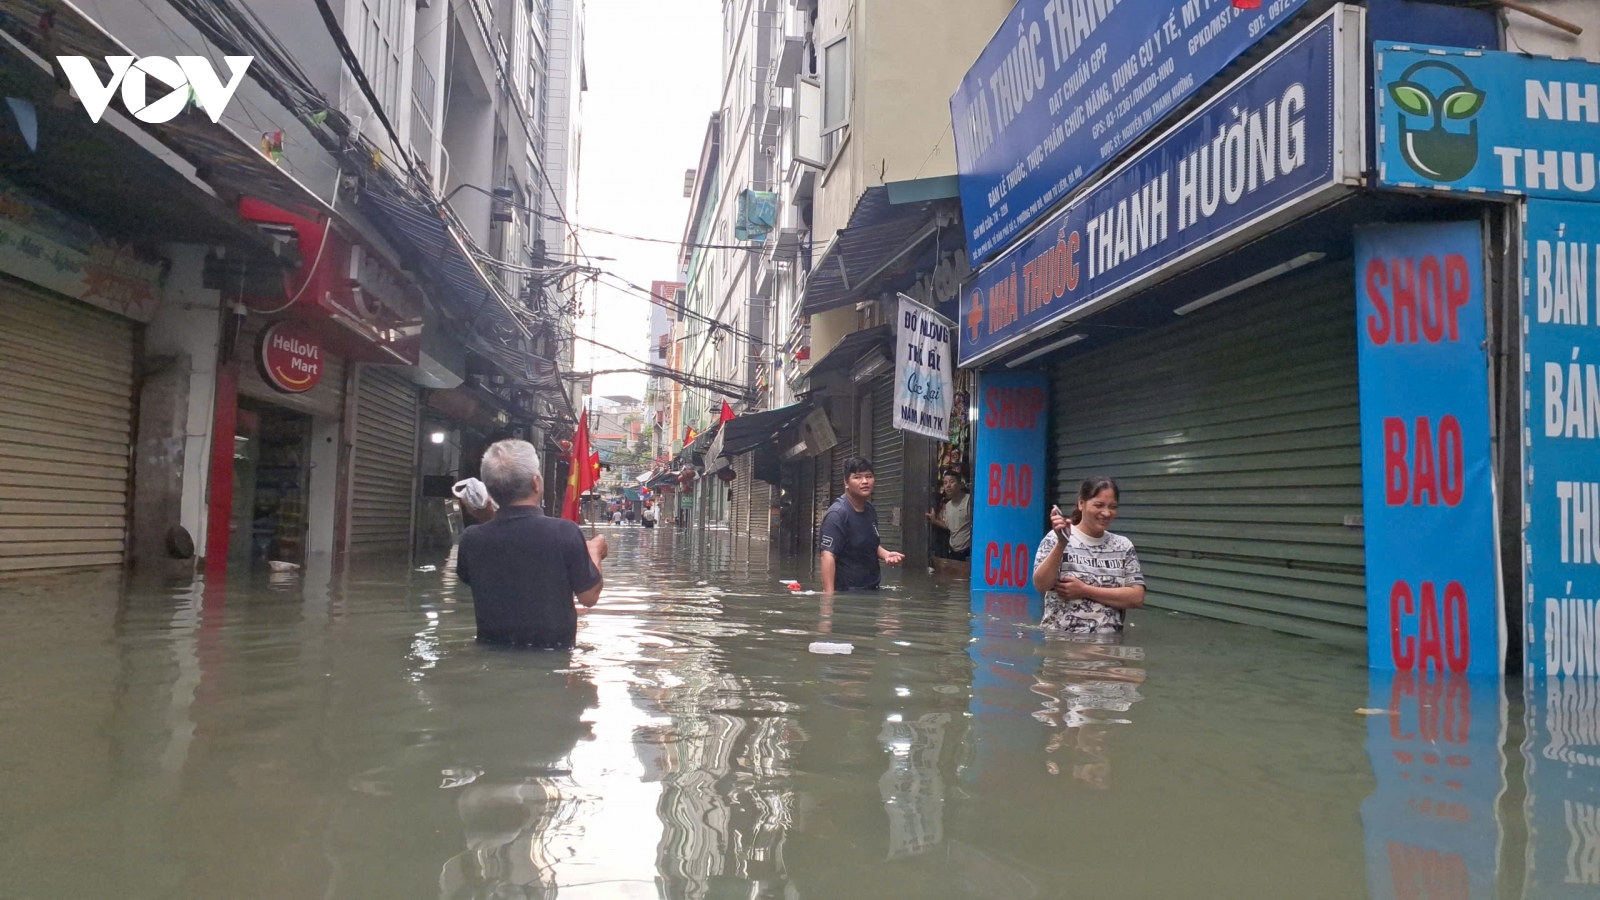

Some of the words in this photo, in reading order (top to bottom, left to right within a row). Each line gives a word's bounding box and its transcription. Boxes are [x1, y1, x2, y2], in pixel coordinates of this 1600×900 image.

[990, 7, 1046, 134] THUỐC
[1026, 145, 1044, 172] THỰC
[1043, 122, 1065, 157] PHẨM
[1064, 105, 1086, 138] CHỨC
[1085, 82, 1112, 119] NĂNG,
[1111, 54, 1139, 94] DỤNG
[1139, 38, 1155, 68] CỤ
[1153, 28, 1164, 53] Y
[1063, 58, 1091, 102] CHUẨN
[1090, 42, 1108, 75] GPP
[988, 262, 1019, 335] NHÀ
[1023, 216, 1081, 317] THUỐC
[1086, 169, 1169, 281] THANH
[1178, 82, 1307, 231] HƯỜNG
[1493, 146, 1600, 192] THU
[1366, 254, 1470, 346] SHOP
[1537, 222, 1588, 326] BÁN
[273, 334, 319, 360] HelloVi
[291, 356, 318, 375] Mart
[1545, 346, 1600, 439] BÁN
[985, 386, 1044, 430] SHOP
[988, 462, 1033, 508] BAO
[1383, 414, 1465, 507] BAO
[984, 541, 1029, 588] CAO
[1390, 579, 1471, 674] CAO
